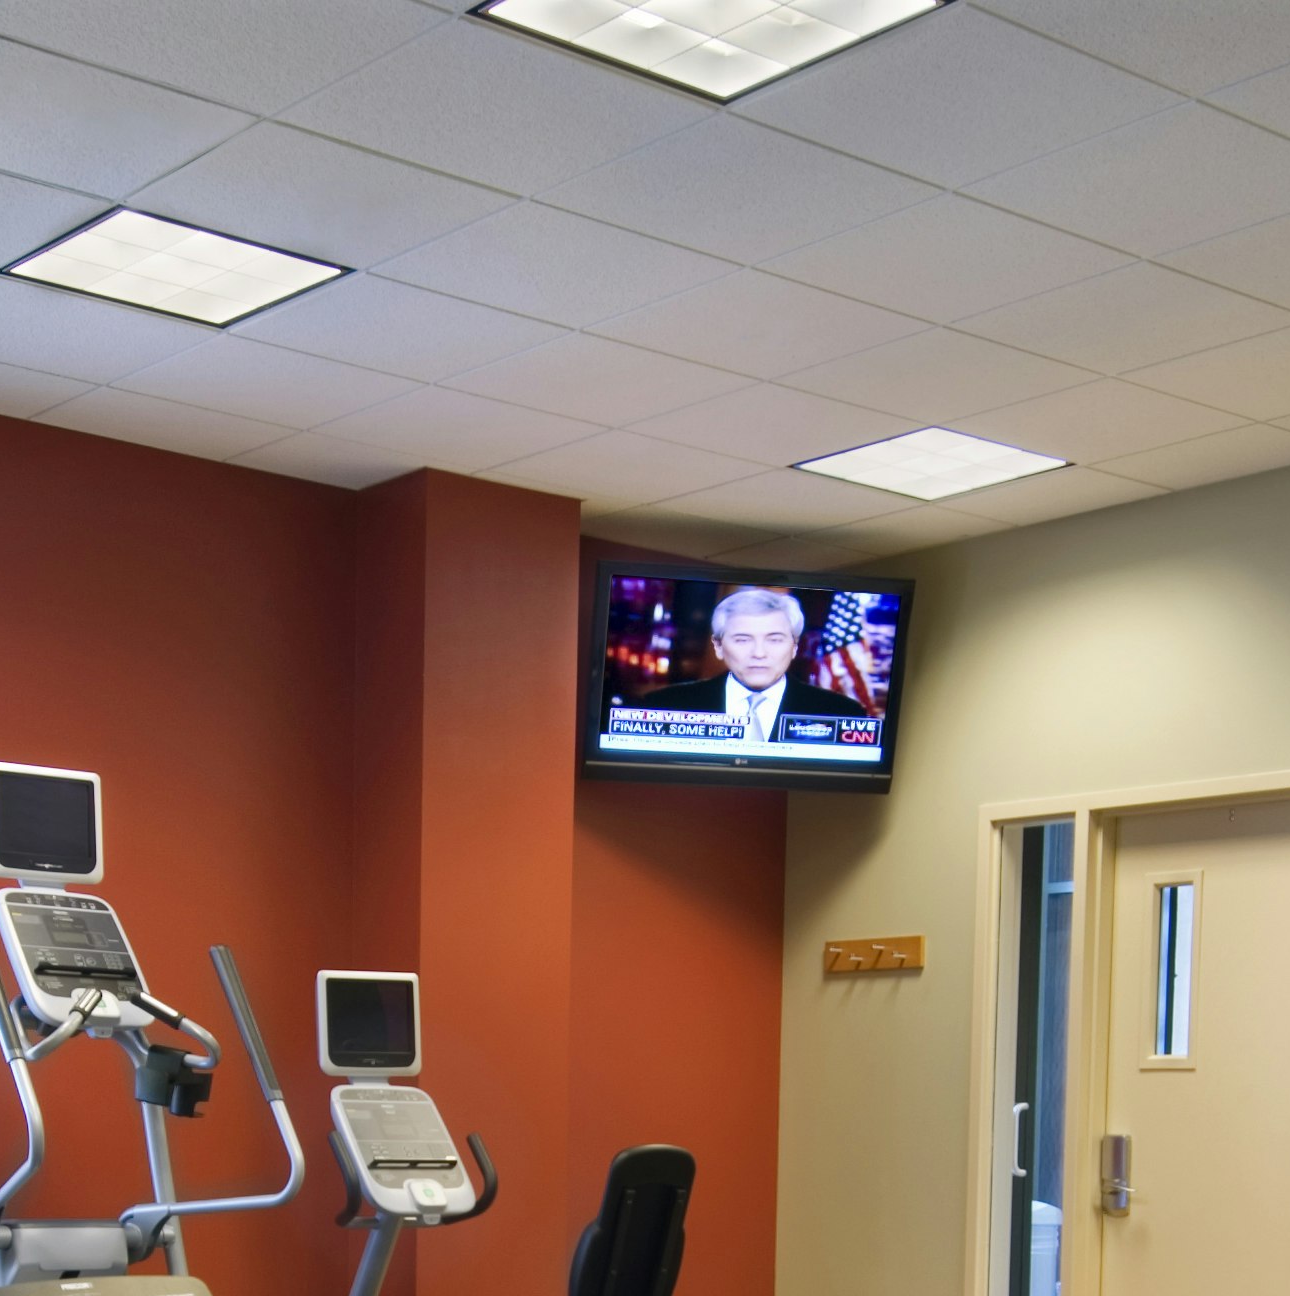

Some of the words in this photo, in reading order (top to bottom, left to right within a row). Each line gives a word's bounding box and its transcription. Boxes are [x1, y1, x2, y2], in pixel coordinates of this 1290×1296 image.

[613, 721, 665, 735] FINALLY,
[669, 724, 705, 736] SOME
[709, 725, 742, 738] HELP!
[842, 720, 876, 731] LIVE
[842, 731, 875, 743] CNN
